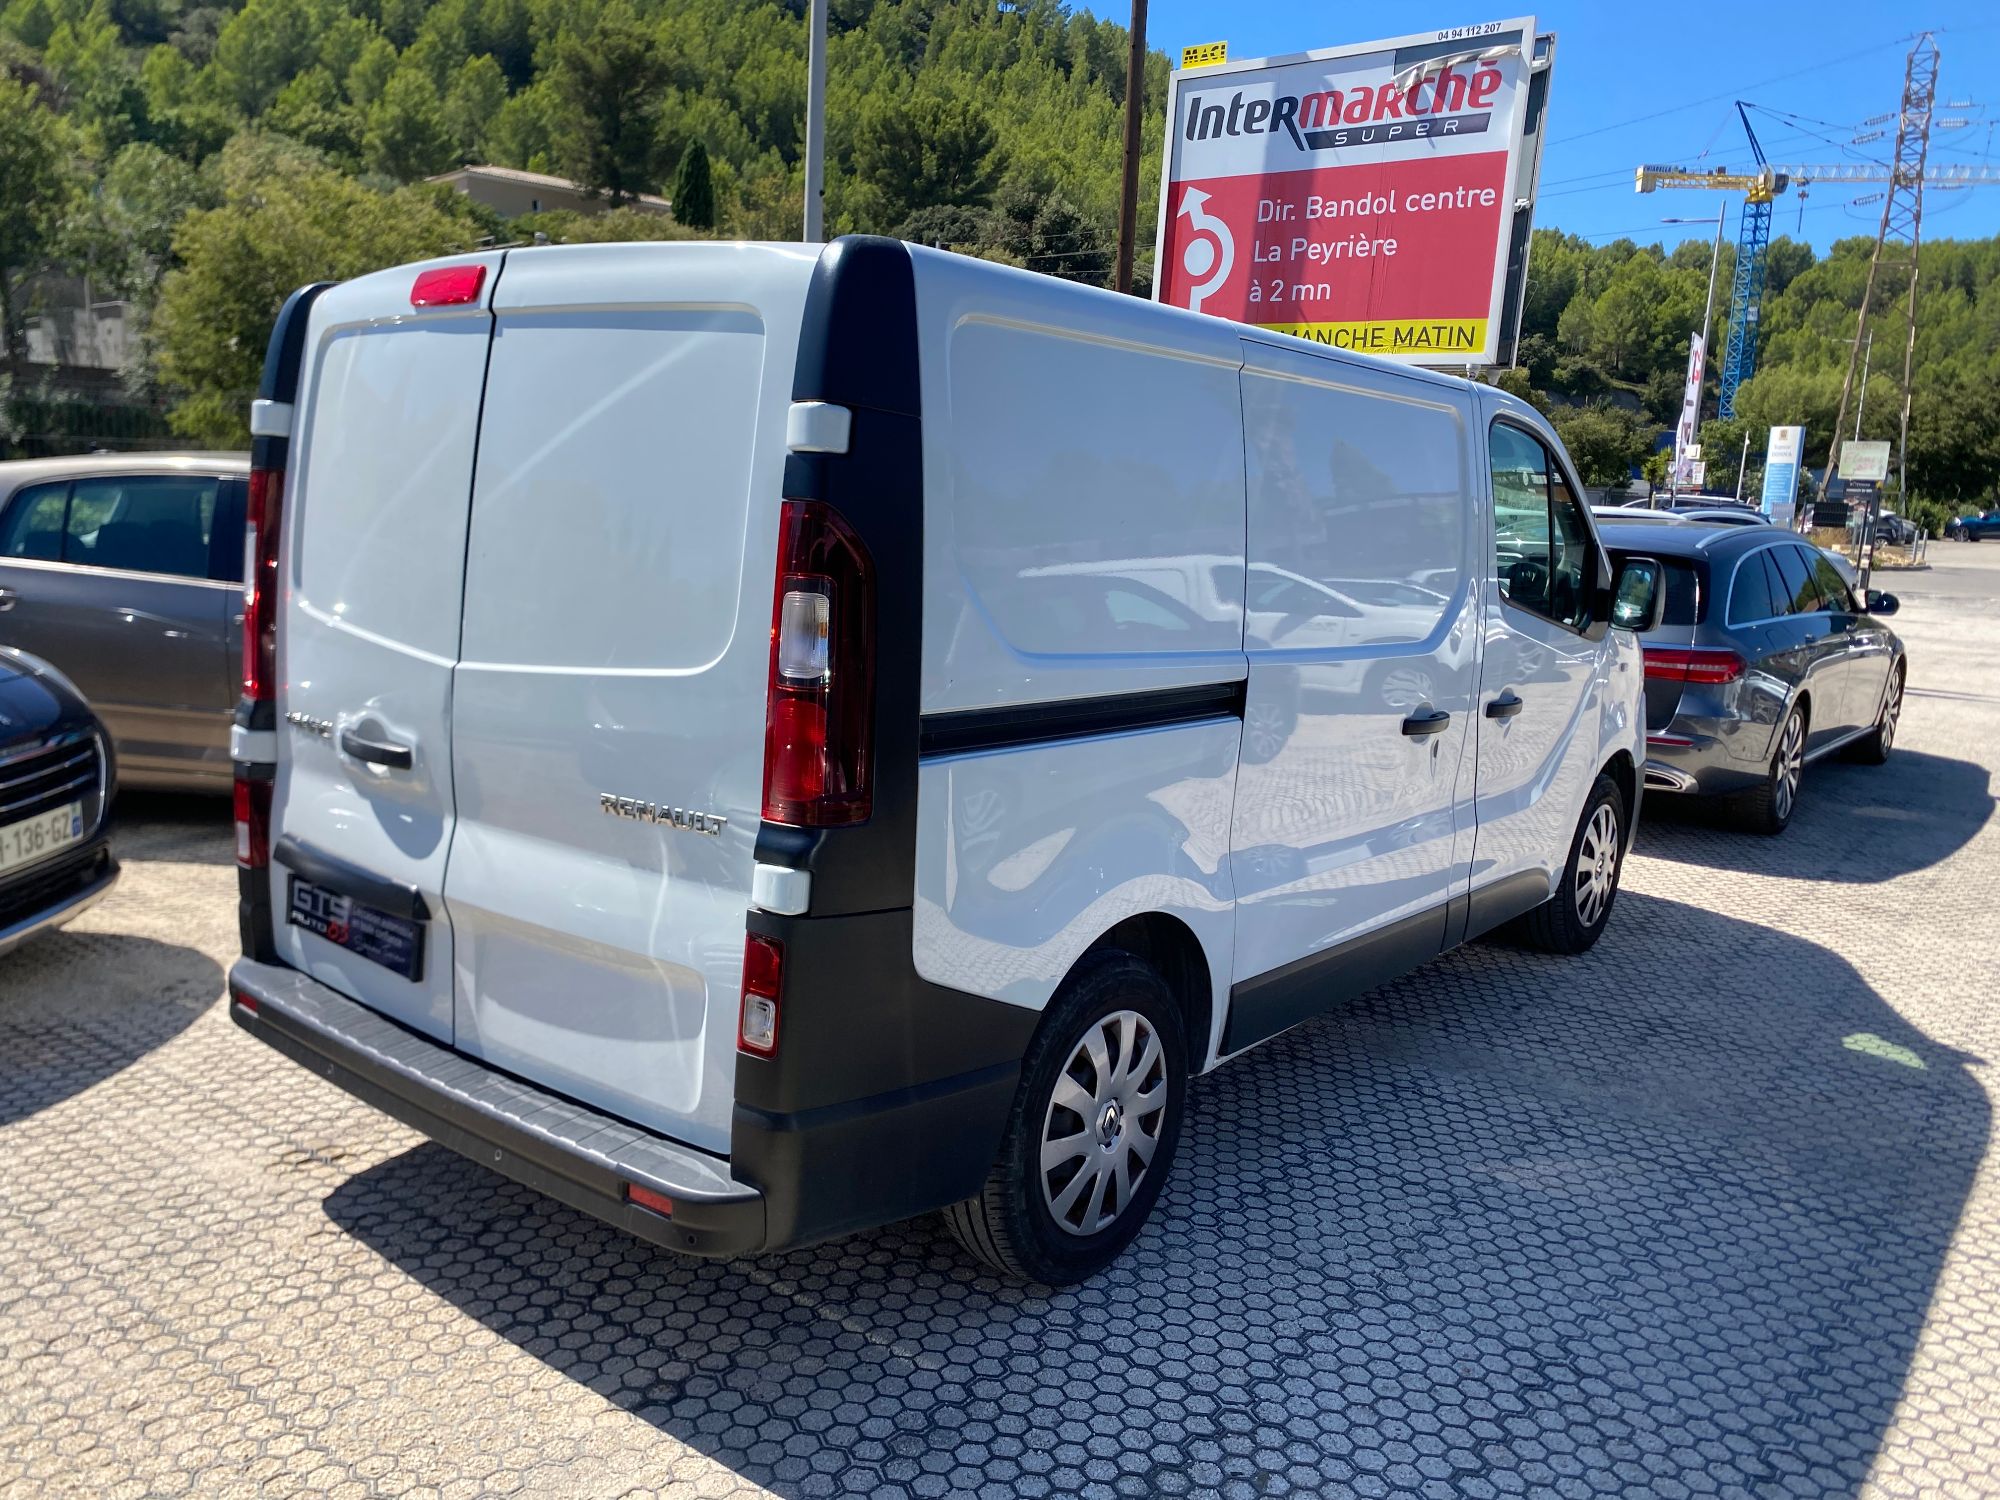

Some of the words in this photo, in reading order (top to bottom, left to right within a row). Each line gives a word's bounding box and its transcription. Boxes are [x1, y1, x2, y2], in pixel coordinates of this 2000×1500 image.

[1437, 30, 1449, 41] 04
[1451, 28, 1463, 39] 94
[1465, 25, 1482, 37] 112
[1483, 22, 1502, 34] 207
[1257, 199, 1296, 223] Dir.
[1306, 189, 1397, 220] Bandol
[1405, 186, 1496, 212] centre
[1254, 240, 1281, 263] La
[1290, 233, 1398, 266] Peyrière
[1249, 279, 1262, 303] à
[1269, 279, 1284, 302] 2
[1291, 282, 1331, 301] mn
[1393, 325, 1476, 348] MATIN
[600, 792, 728, 837] RENAULT
